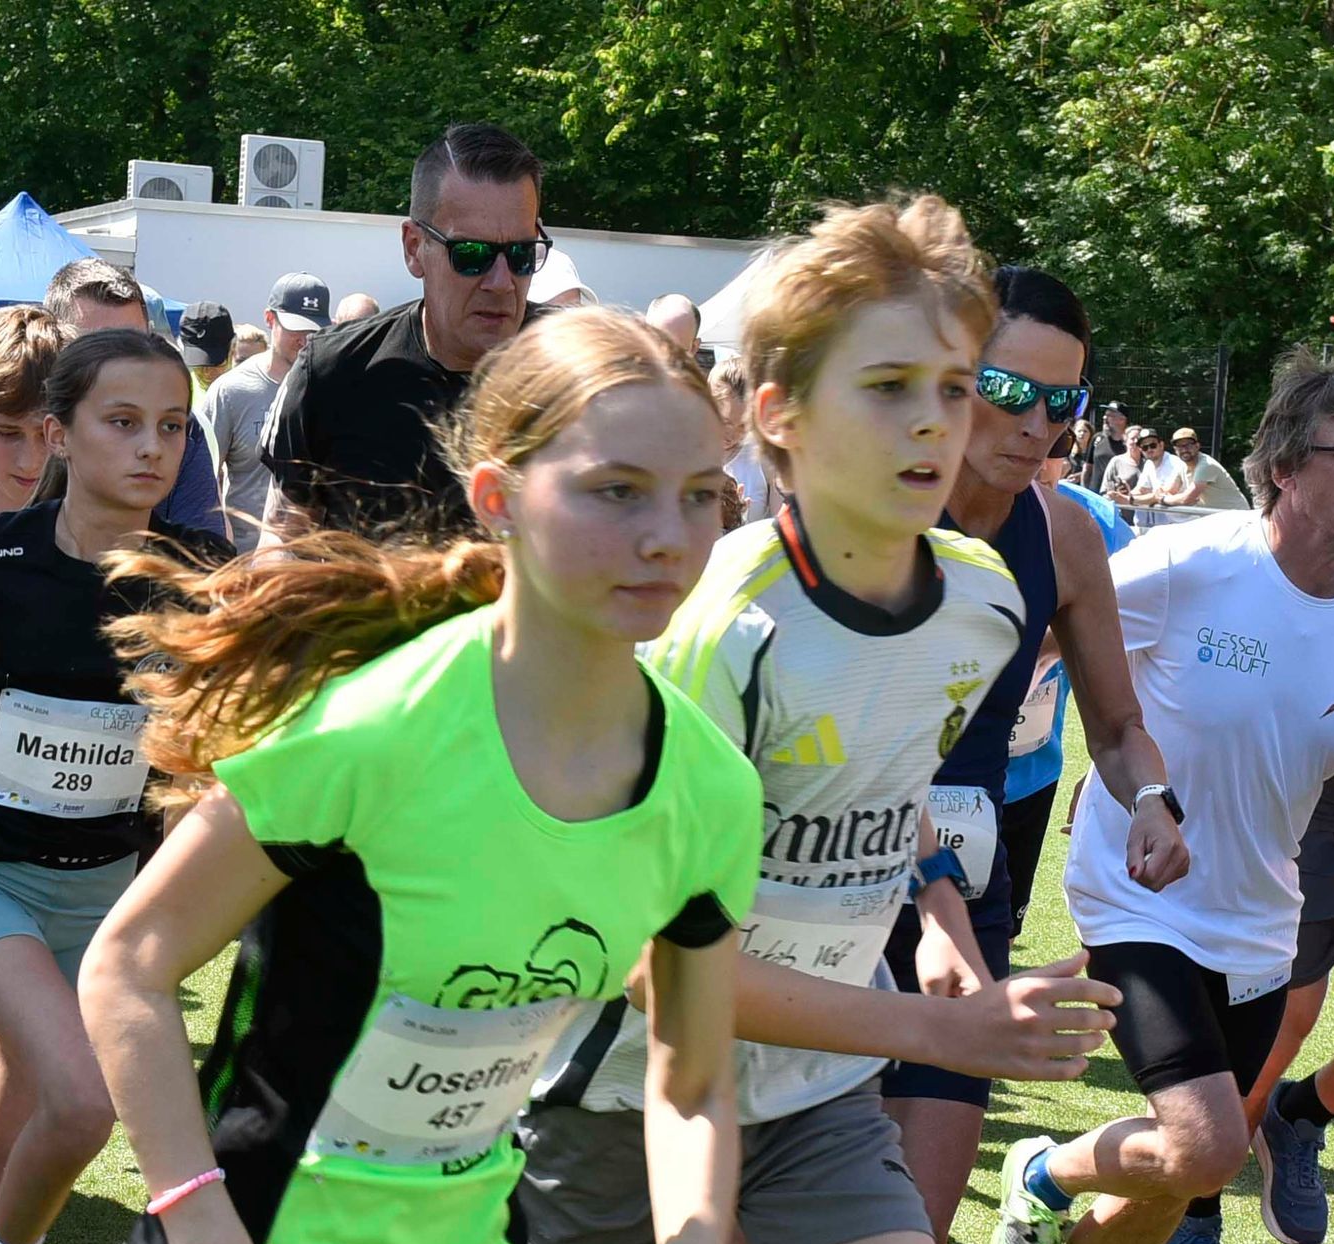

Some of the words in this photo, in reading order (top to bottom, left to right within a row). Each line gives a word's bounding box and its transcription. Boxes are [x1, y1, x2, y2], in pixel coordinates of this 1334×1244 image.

[1197, 626, 1268, 658] GLESSEN
[16, 732, 135, 766] Mathilda
[51, 771, 93, 792] 289
[426, 1101, 486, 1130] 457
